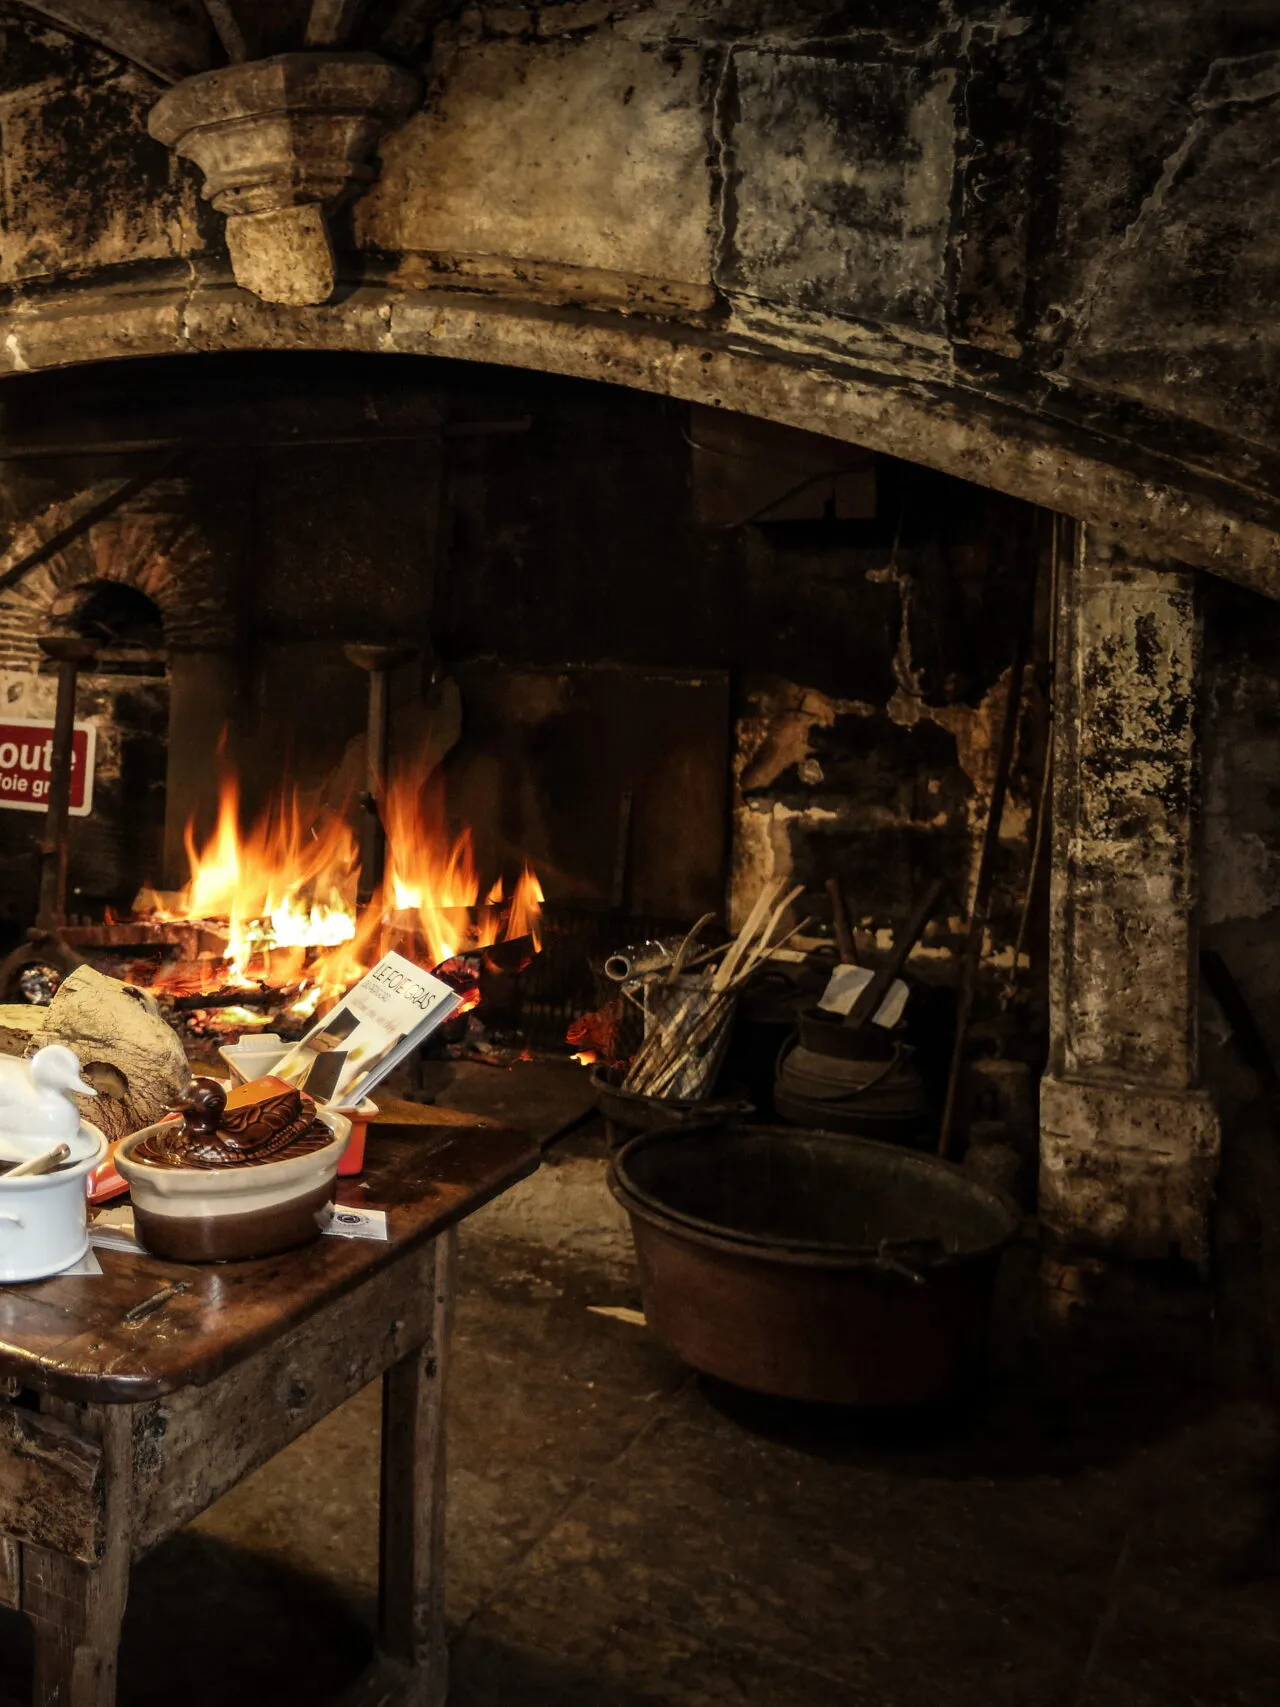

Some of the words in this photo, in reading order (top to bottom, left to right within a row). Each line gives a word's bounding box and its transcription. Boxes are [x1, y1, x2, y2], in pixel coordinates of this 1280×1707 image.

[372, 963, 393, 981] LE
[383, 970, 412, 994] FOIE
[404, 984, 436, 1010] GRAS
